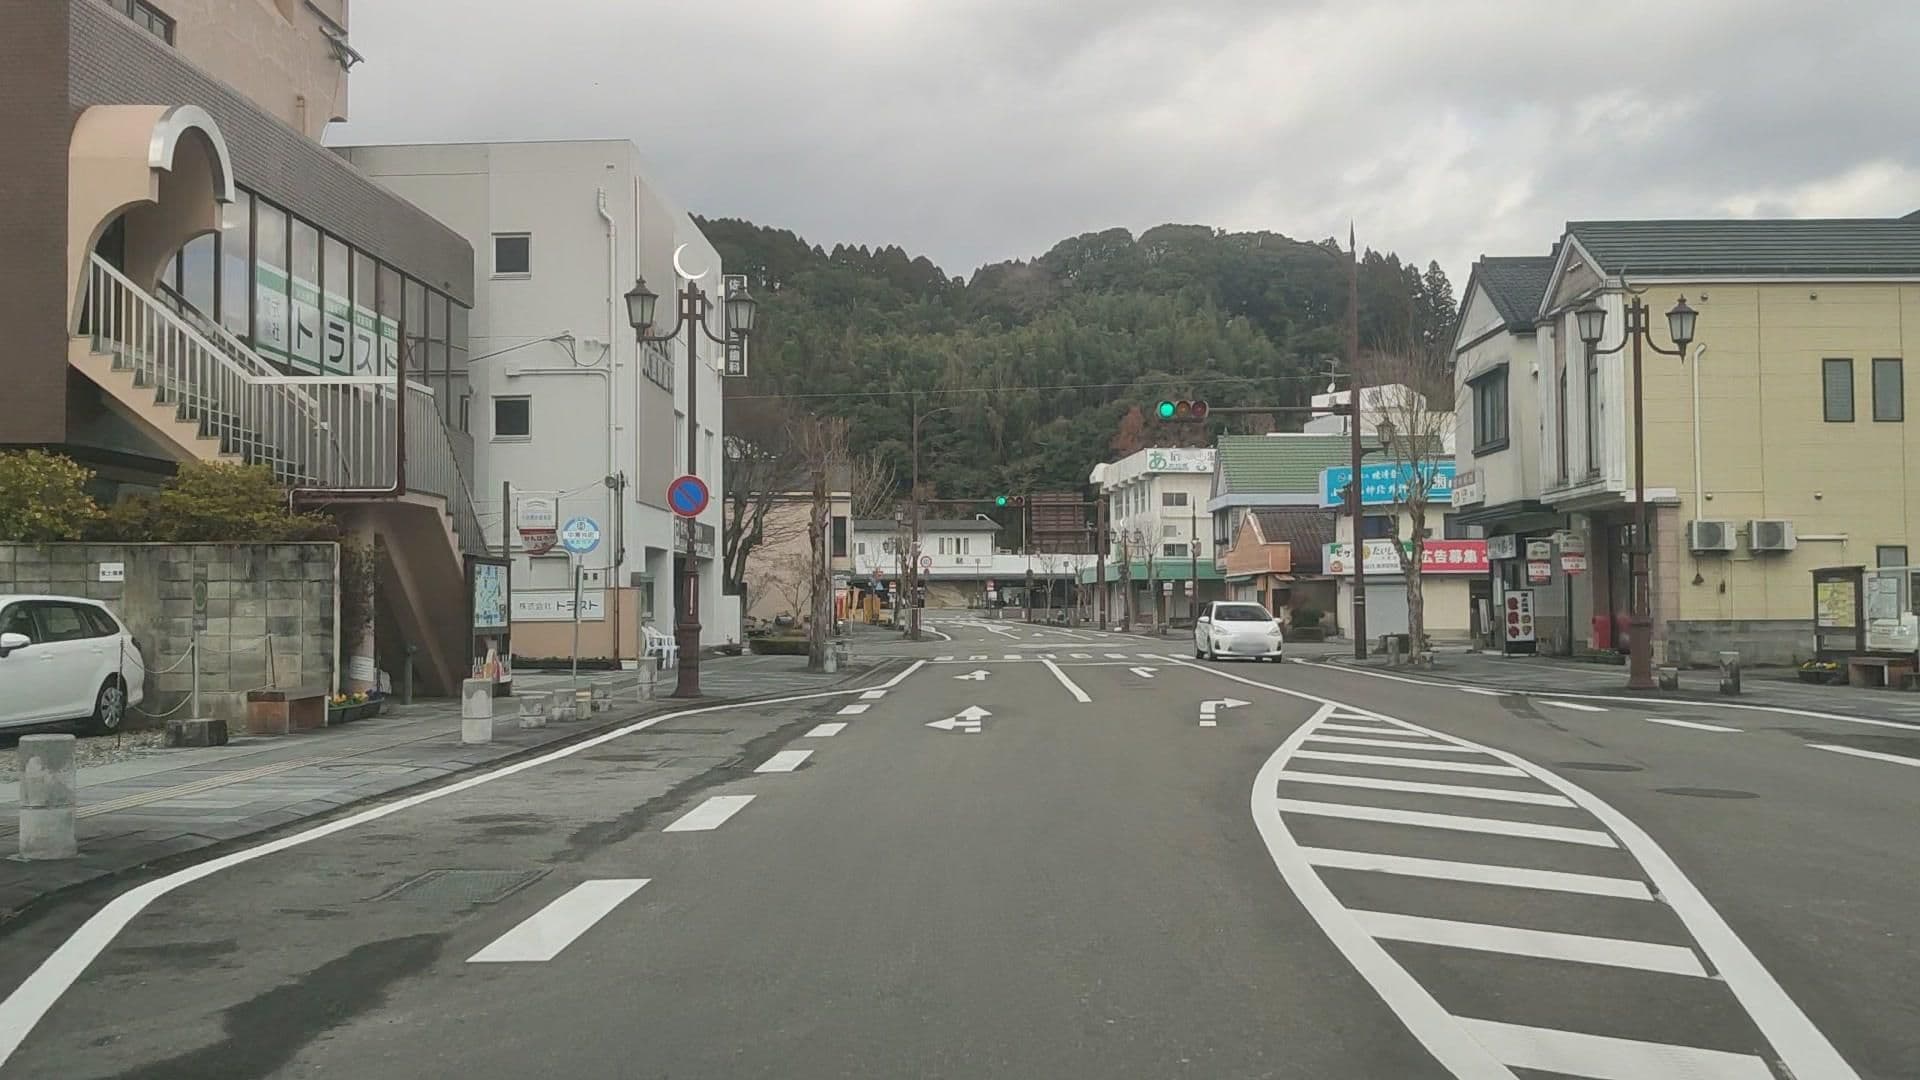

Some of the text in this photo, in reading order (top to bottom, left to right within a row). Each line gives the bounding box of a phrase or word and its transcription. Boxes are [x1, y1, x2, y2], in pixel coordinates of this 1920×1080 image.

[298, 306, 397, 376] トラスト
[556, 600, 599, 611] トラスト
